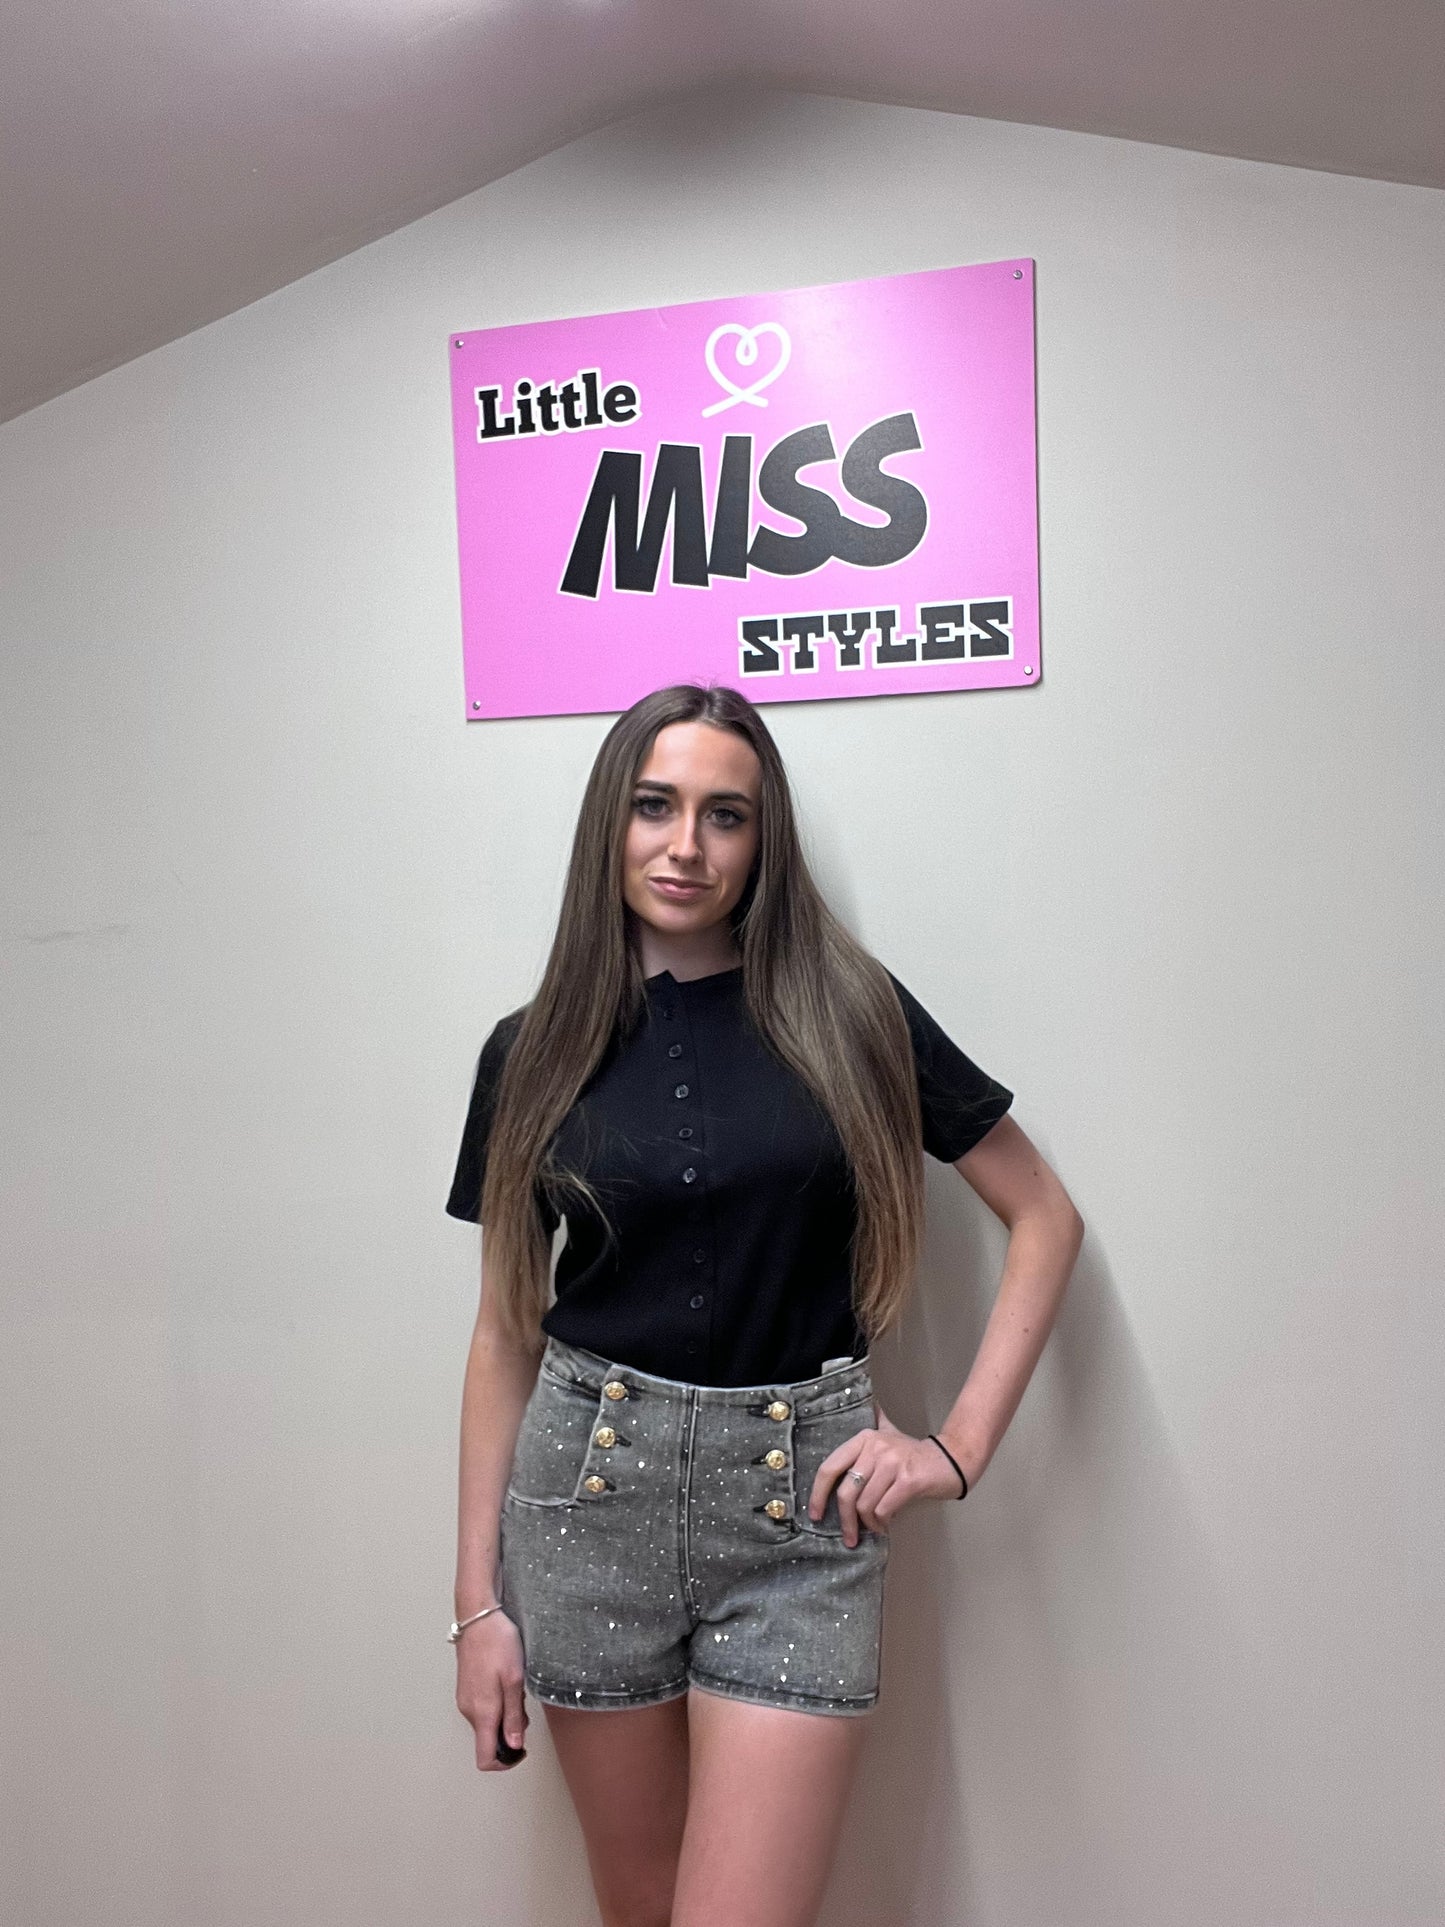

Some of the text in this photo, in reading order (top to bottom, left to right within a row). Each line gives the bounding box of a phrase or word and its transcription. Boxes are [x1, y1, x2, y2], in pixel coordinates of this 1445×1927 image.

[477, 371, 638, 439] Little
[559, 412, 927, 598] MISS
[742, 600, 1010, 674] STYLES
